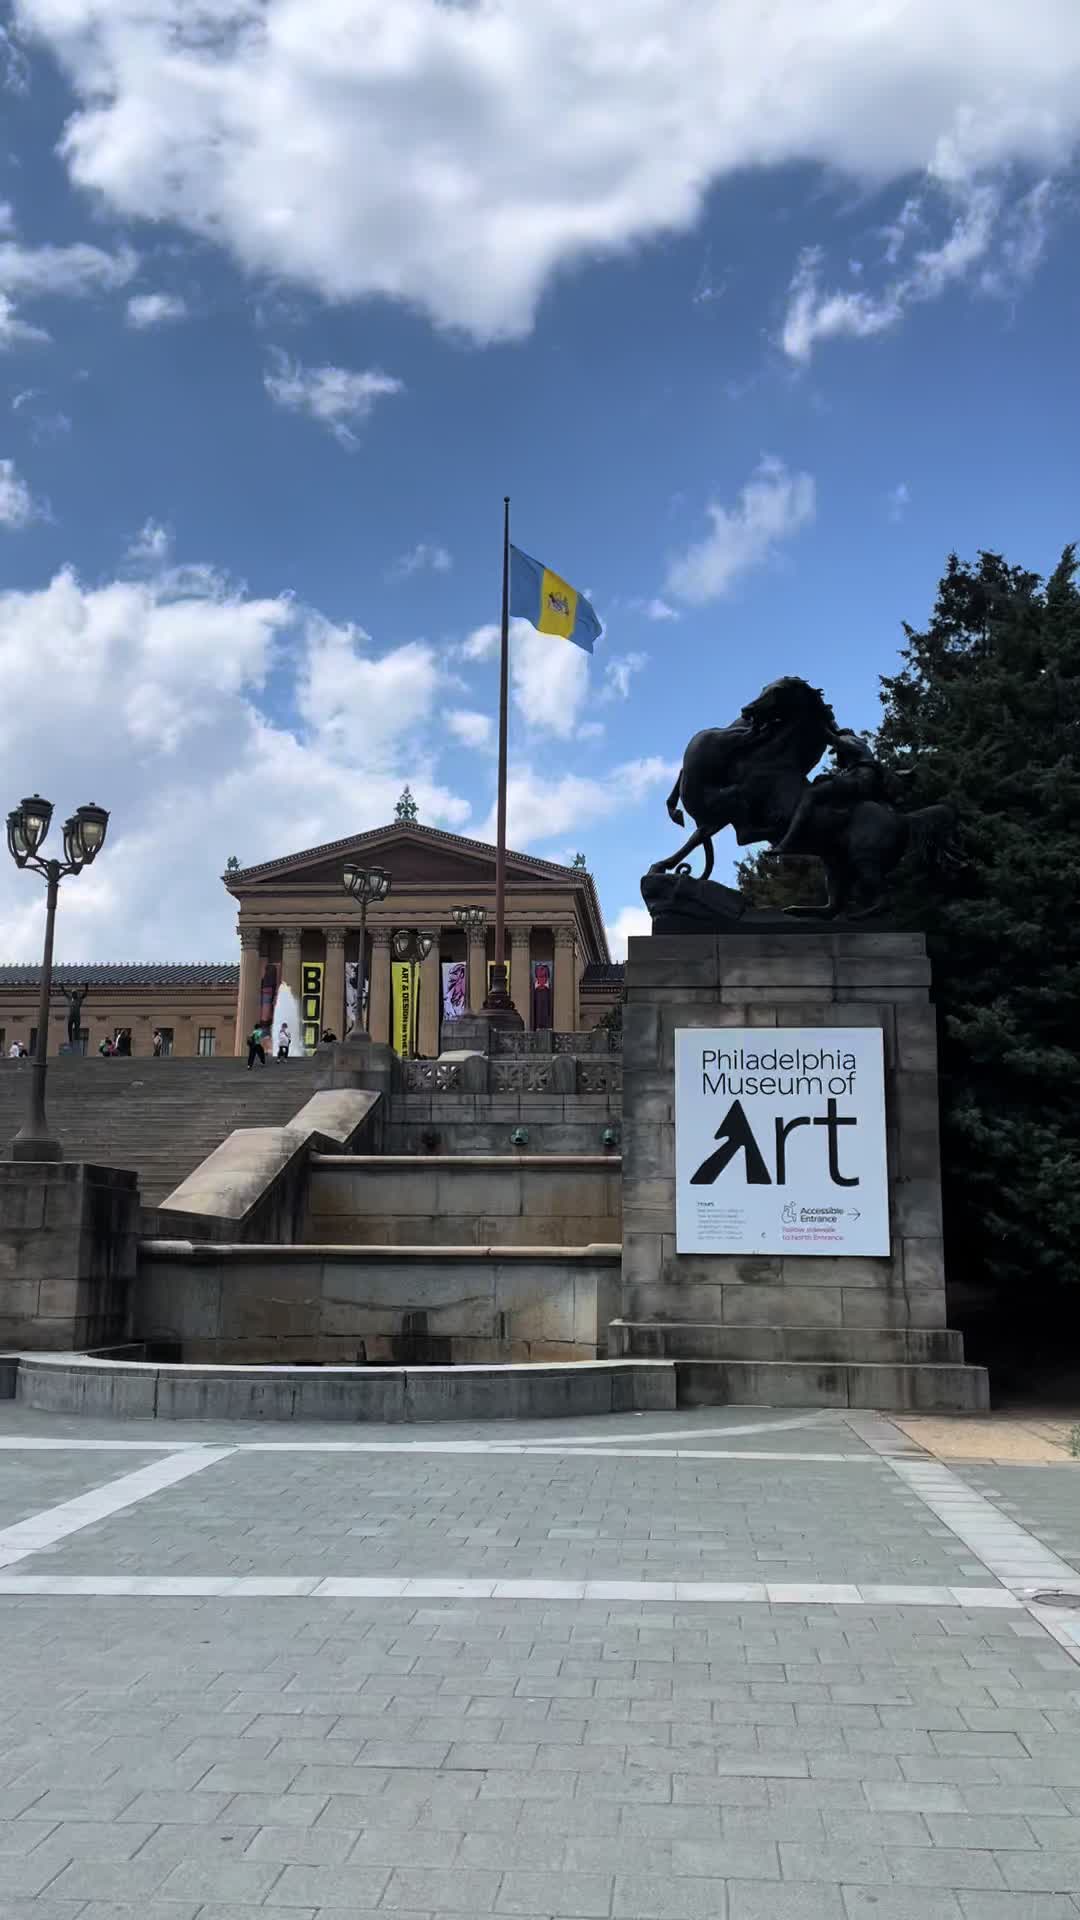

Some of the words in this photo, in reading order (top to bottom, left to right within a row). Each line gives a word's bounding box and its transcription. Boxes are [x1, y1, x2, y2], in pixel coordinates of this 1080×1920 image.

[702, 1048, 856, 1075] Philadelphia
[703, 1072, 823, 1095] Museum
[828, 1071, 856, 1095] of
[689, 1098, 859, 1187] Art
[800, 1215, 838, 1223] Entrance
